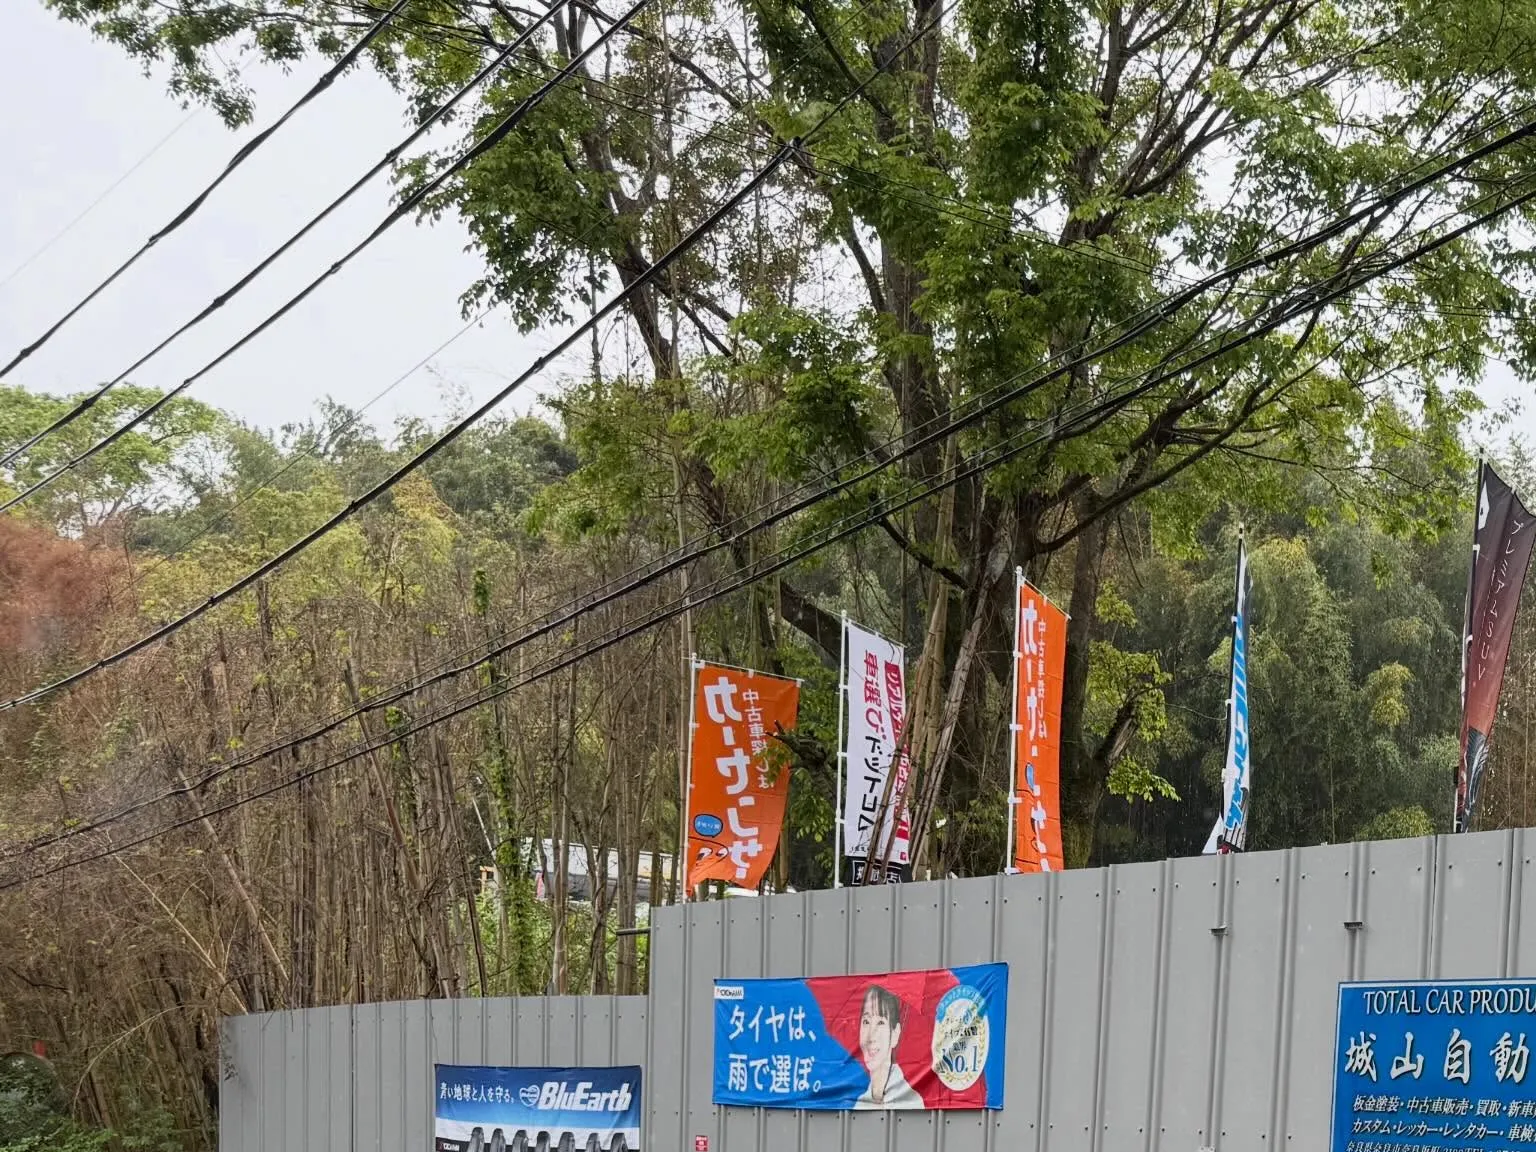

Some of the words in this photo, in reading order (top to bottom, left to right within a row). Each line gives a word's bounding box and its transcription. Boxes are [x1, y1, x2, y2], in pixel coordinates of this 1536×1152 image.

[1363, 989, 1422, 1015] TOTAL
[1425, 988, 1465, 1015] CAR
[728, 1004, 817, 1043] タイヤは、
[727, 1052, 822, 1094] 雨で選ぼ。
[937, 1045, 978, 1074] No.1
[537, 1080, 633, 1112] BluEarth
